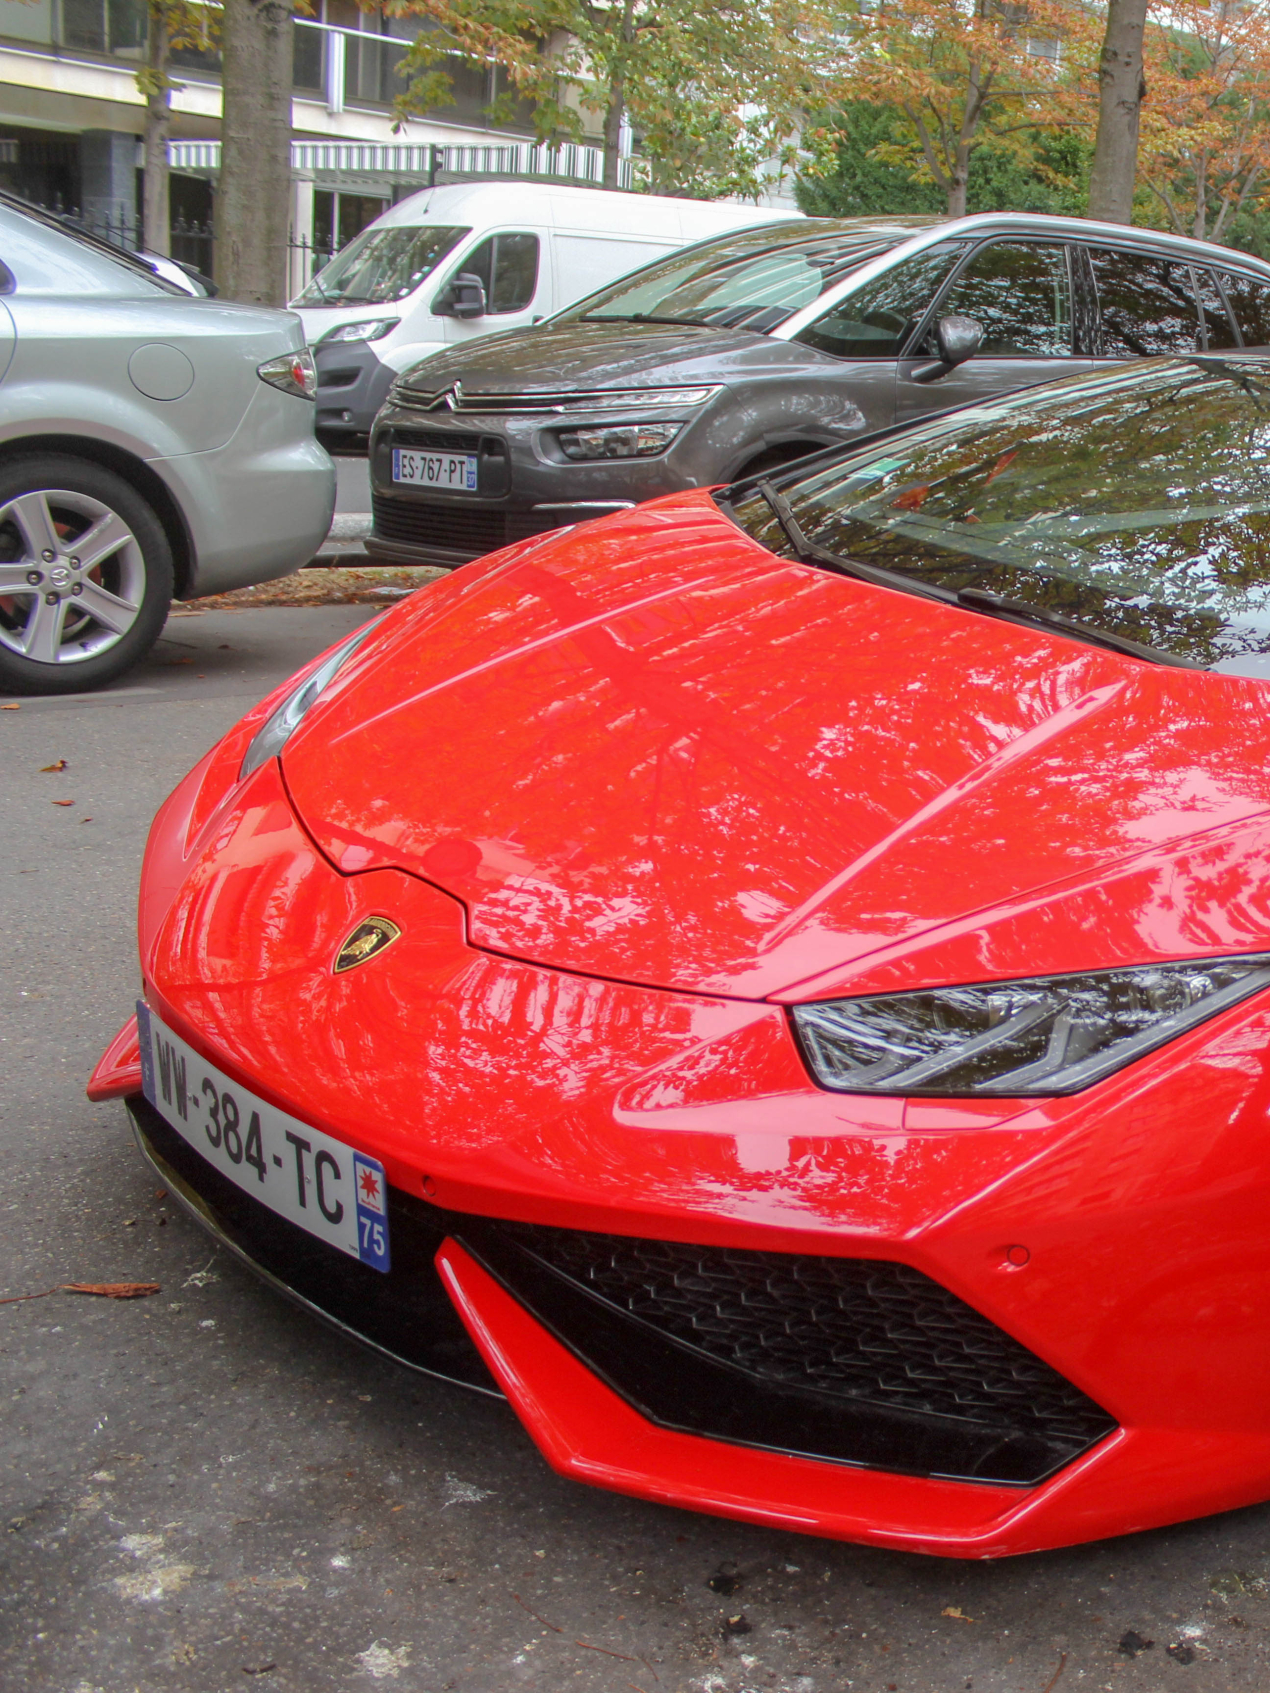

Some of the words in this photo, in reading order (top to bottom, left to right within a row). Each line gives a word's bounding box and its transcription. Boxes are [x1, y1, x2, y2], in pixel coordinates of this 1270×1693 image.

[401, 454, 466, 484] ES-767-PT
[155, 1030, 344, 1225] WW-384-TC
[359, 1215, 385, 1256] 75
